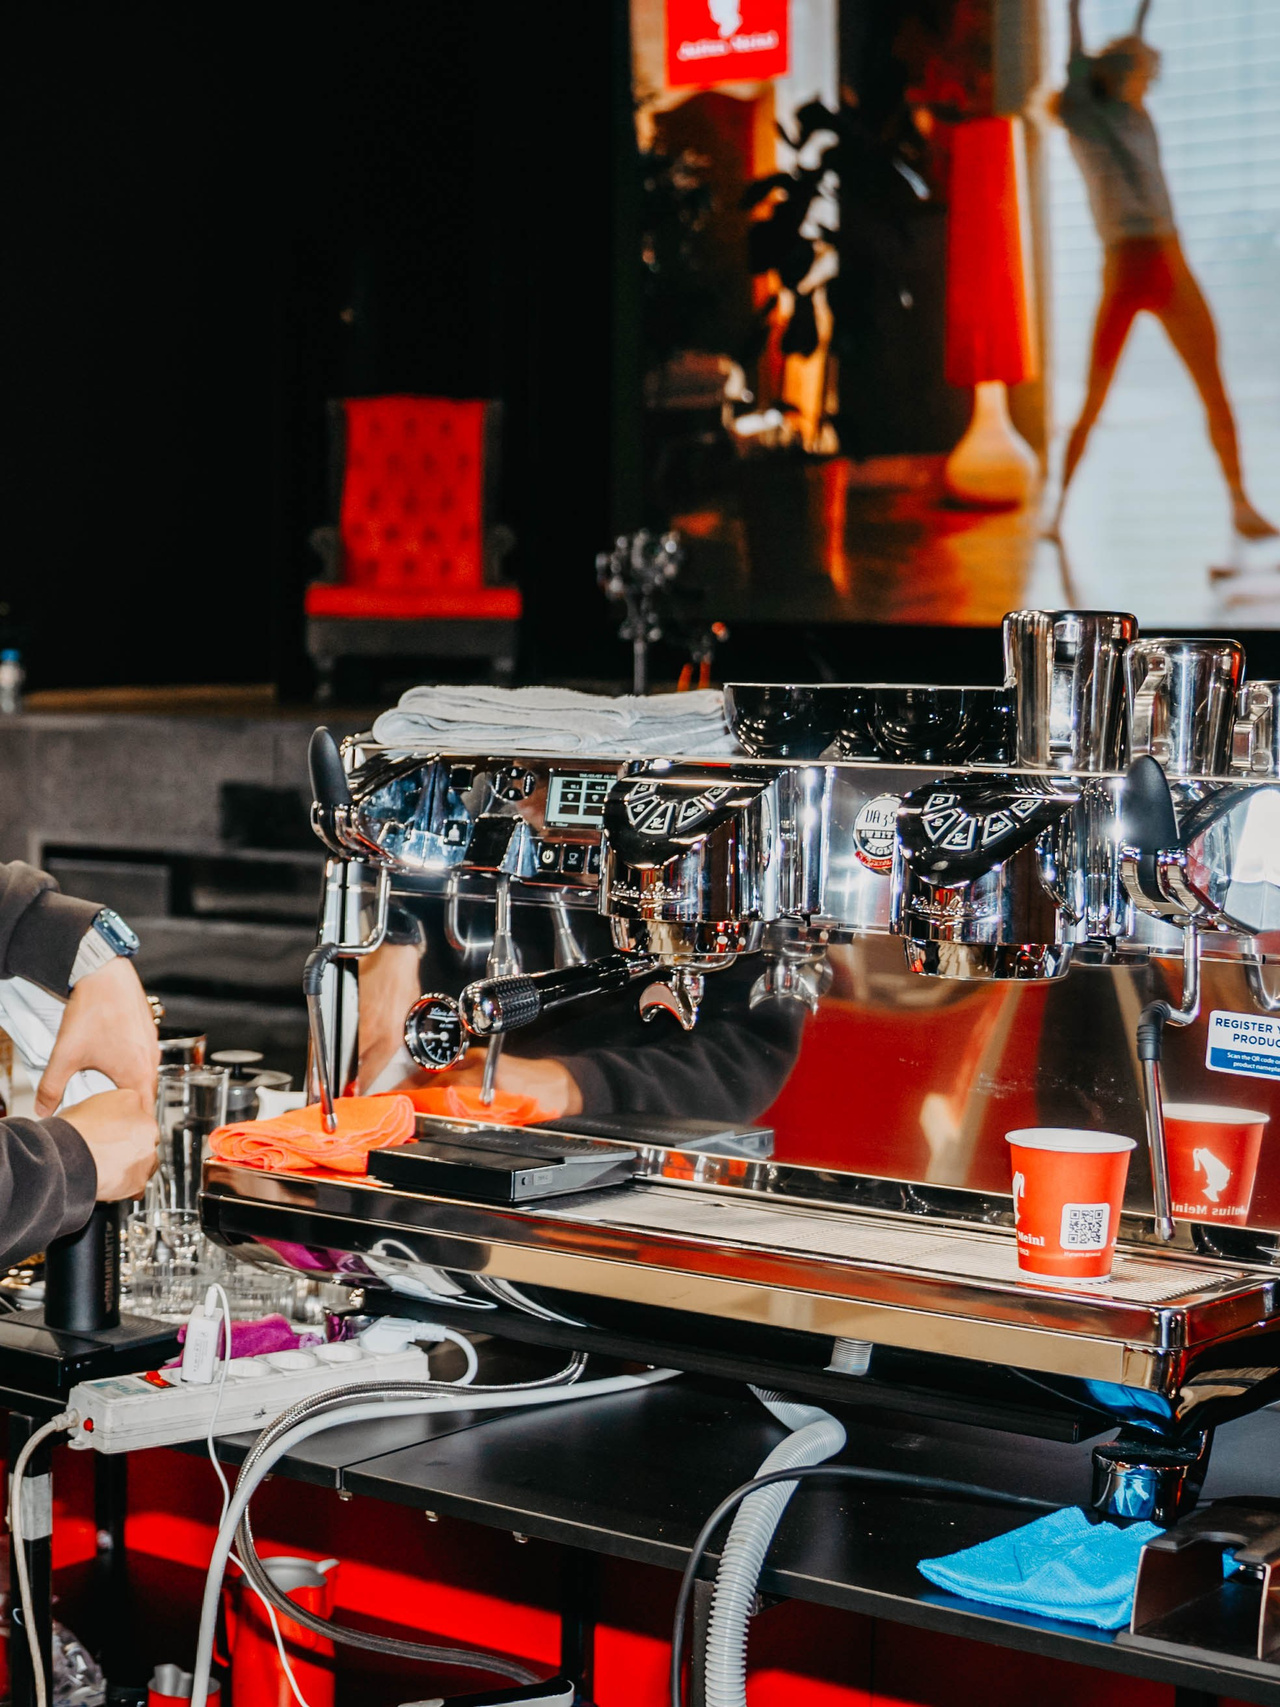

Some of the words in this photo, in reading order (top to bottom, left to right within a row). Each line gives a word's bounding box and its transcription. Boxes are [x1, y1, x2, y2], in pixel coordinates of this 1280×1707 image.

[1215, 1017, 1273, 1033] REGISTER
[1233, 1033, 1280, 1048] PRODUC
[1227, 1052, 1241, 1060] Scan
[1260, 1057, 1274, 1065] code
[1233, 1061, 1255, 1069] product
